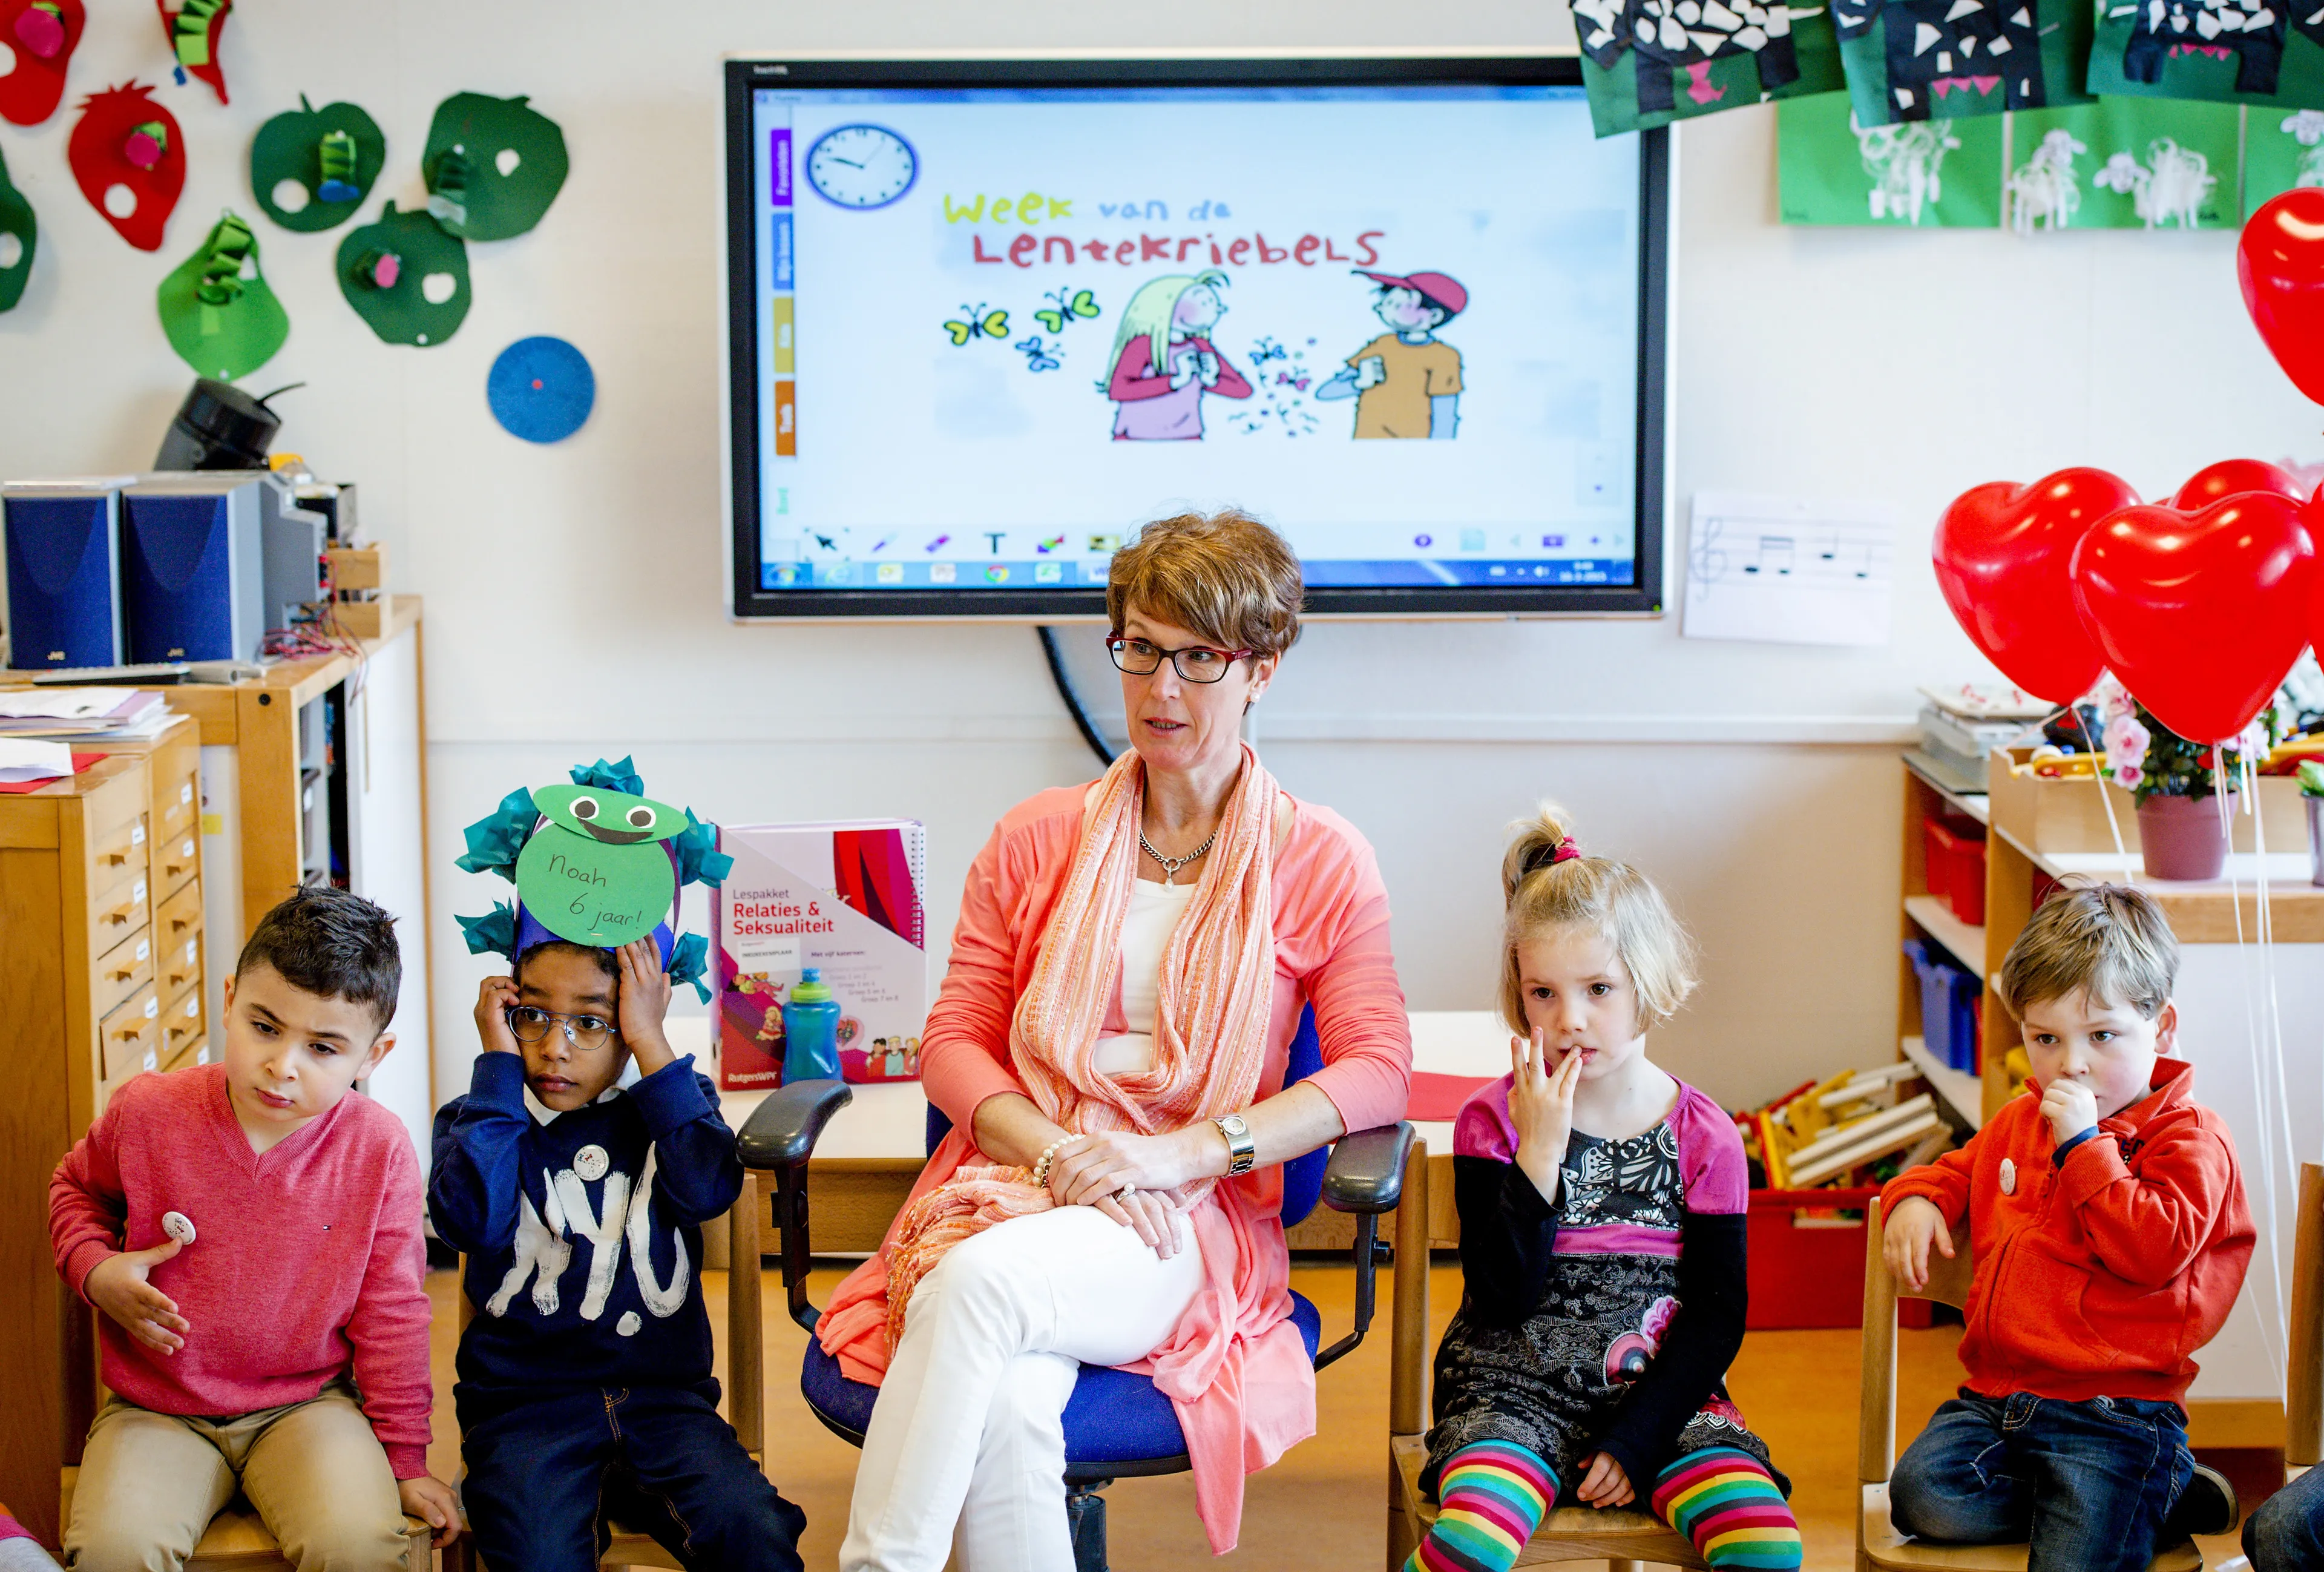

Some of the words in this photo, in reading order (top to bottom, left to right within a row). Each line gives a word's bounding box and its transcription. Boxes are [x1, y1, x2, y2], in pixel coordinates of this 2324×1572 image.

[944, 192, 1072, 225] Week
[1098, 200, 1169, 221] van
[733, 889, 790, 901] Lespakket
[570, 892, 588, 915] 6
[587, 903, 642, 931] jaar!
[734, 902, 801, 918] Relaties
[809, 901, 819, 916] &
[734, 918, 835, 935] Seksualiteit
